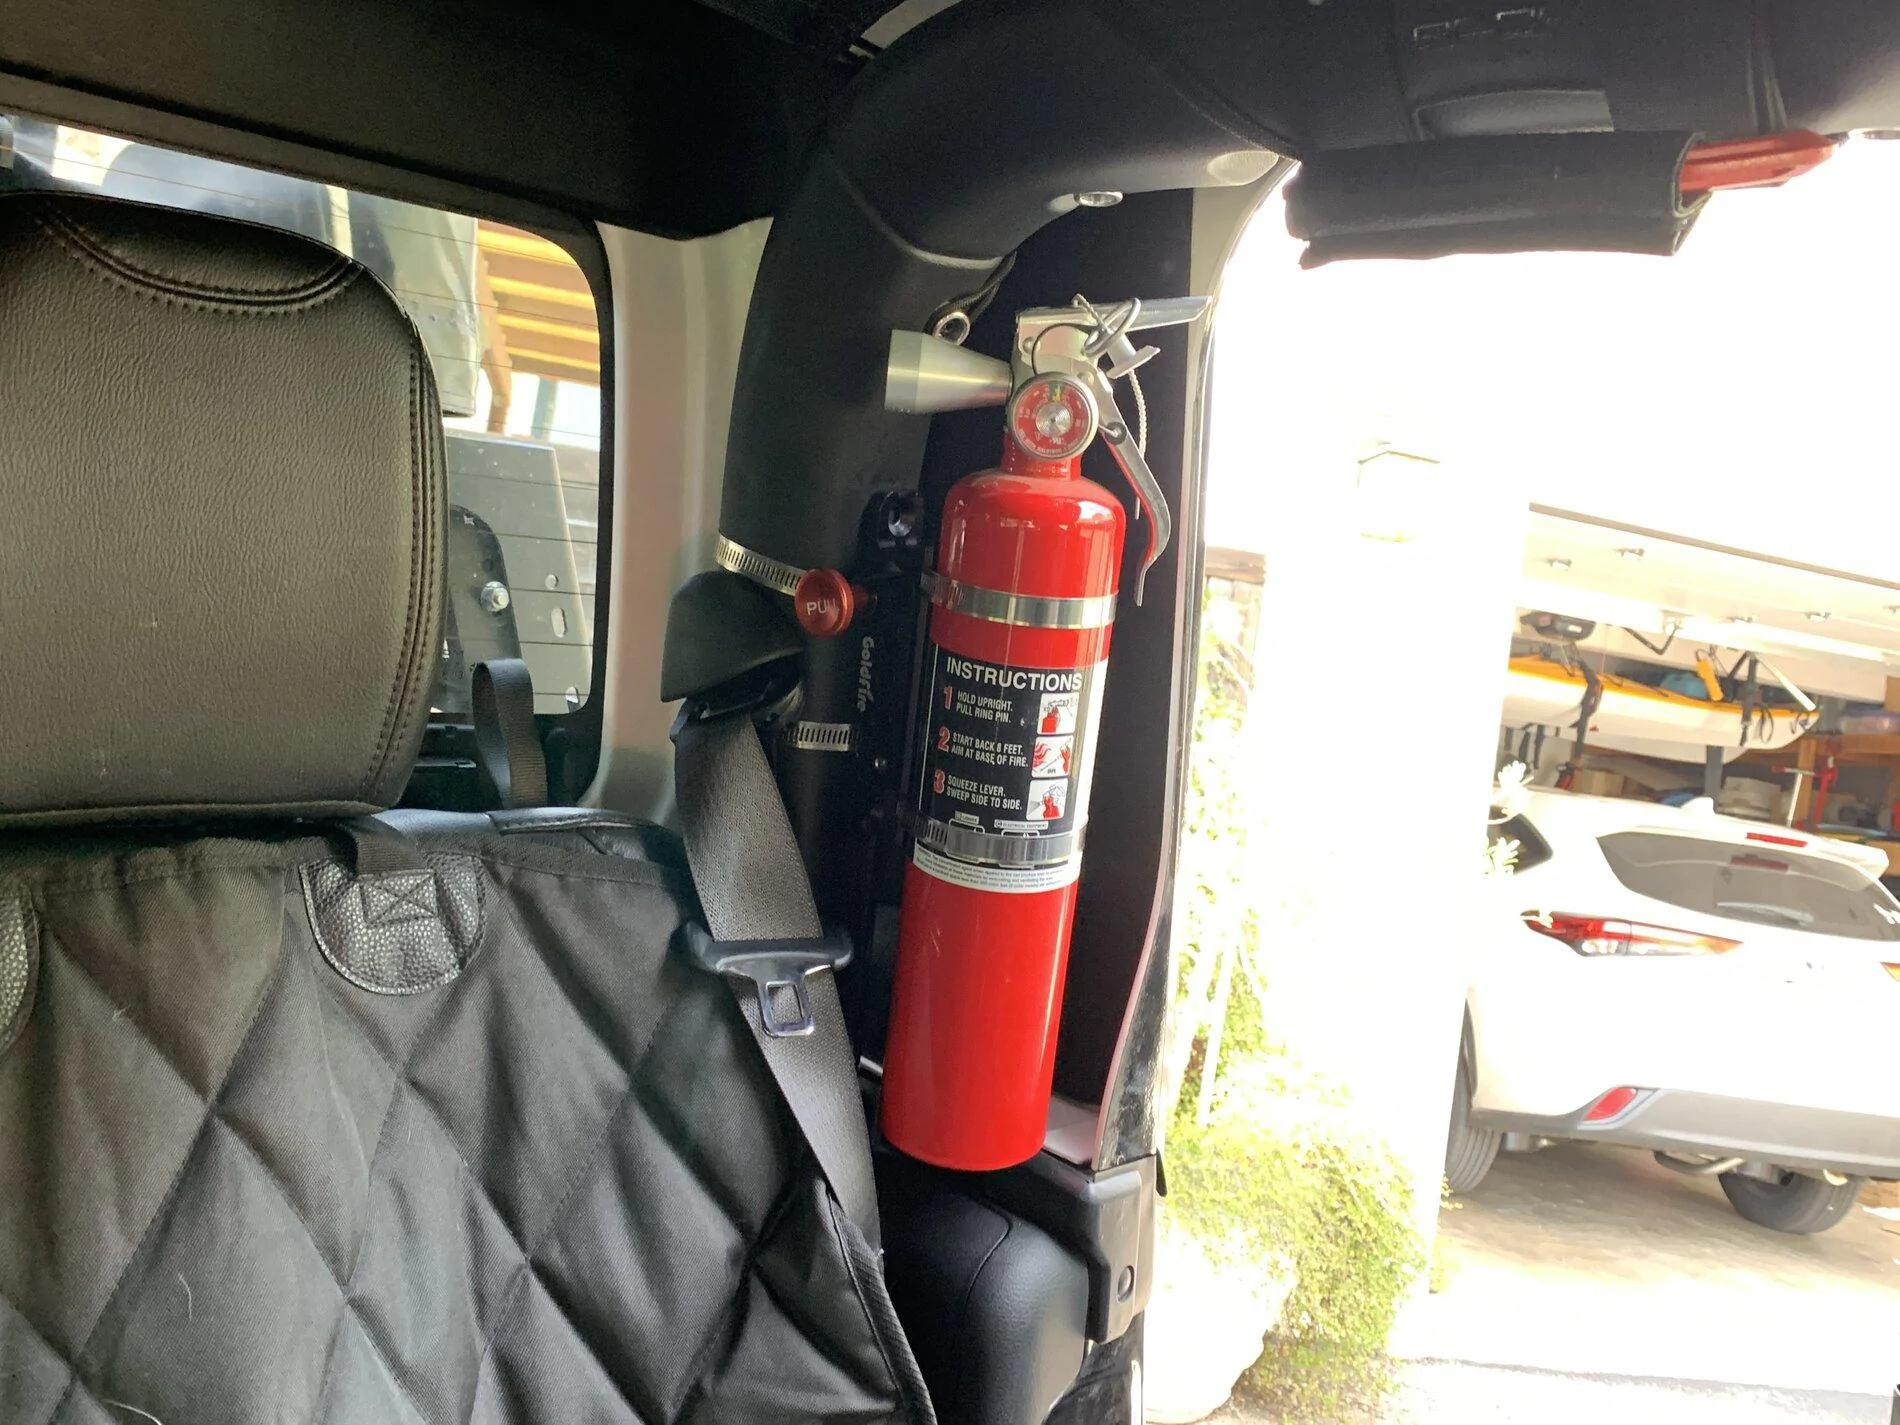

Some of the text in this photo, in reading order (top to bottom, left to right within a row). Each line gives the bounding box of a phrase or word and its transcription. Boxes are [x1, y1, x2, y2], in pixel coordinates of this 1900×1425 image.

[946, 656, 1082, 691] INSTRUCTIONS
[943, 685, 953, 710] 1
[957, 691, 1013, 712] HOLD UPRIGHT.
[956, 702, 1012, 723] PULL RING PIN.
[937, 725, 950, 753] 2
[952, 732, 1023, 755] START BACK 8 FEET.
[951, 745, 1029, 768] AIM AT BASE OF FIRE.
[933, 768, 945, 794] 3
[948, 774, 1006, 797] SQUEEZE LEVER.
[946, 786, 1022, 810] SWEEP SIDE TO SIDE.
